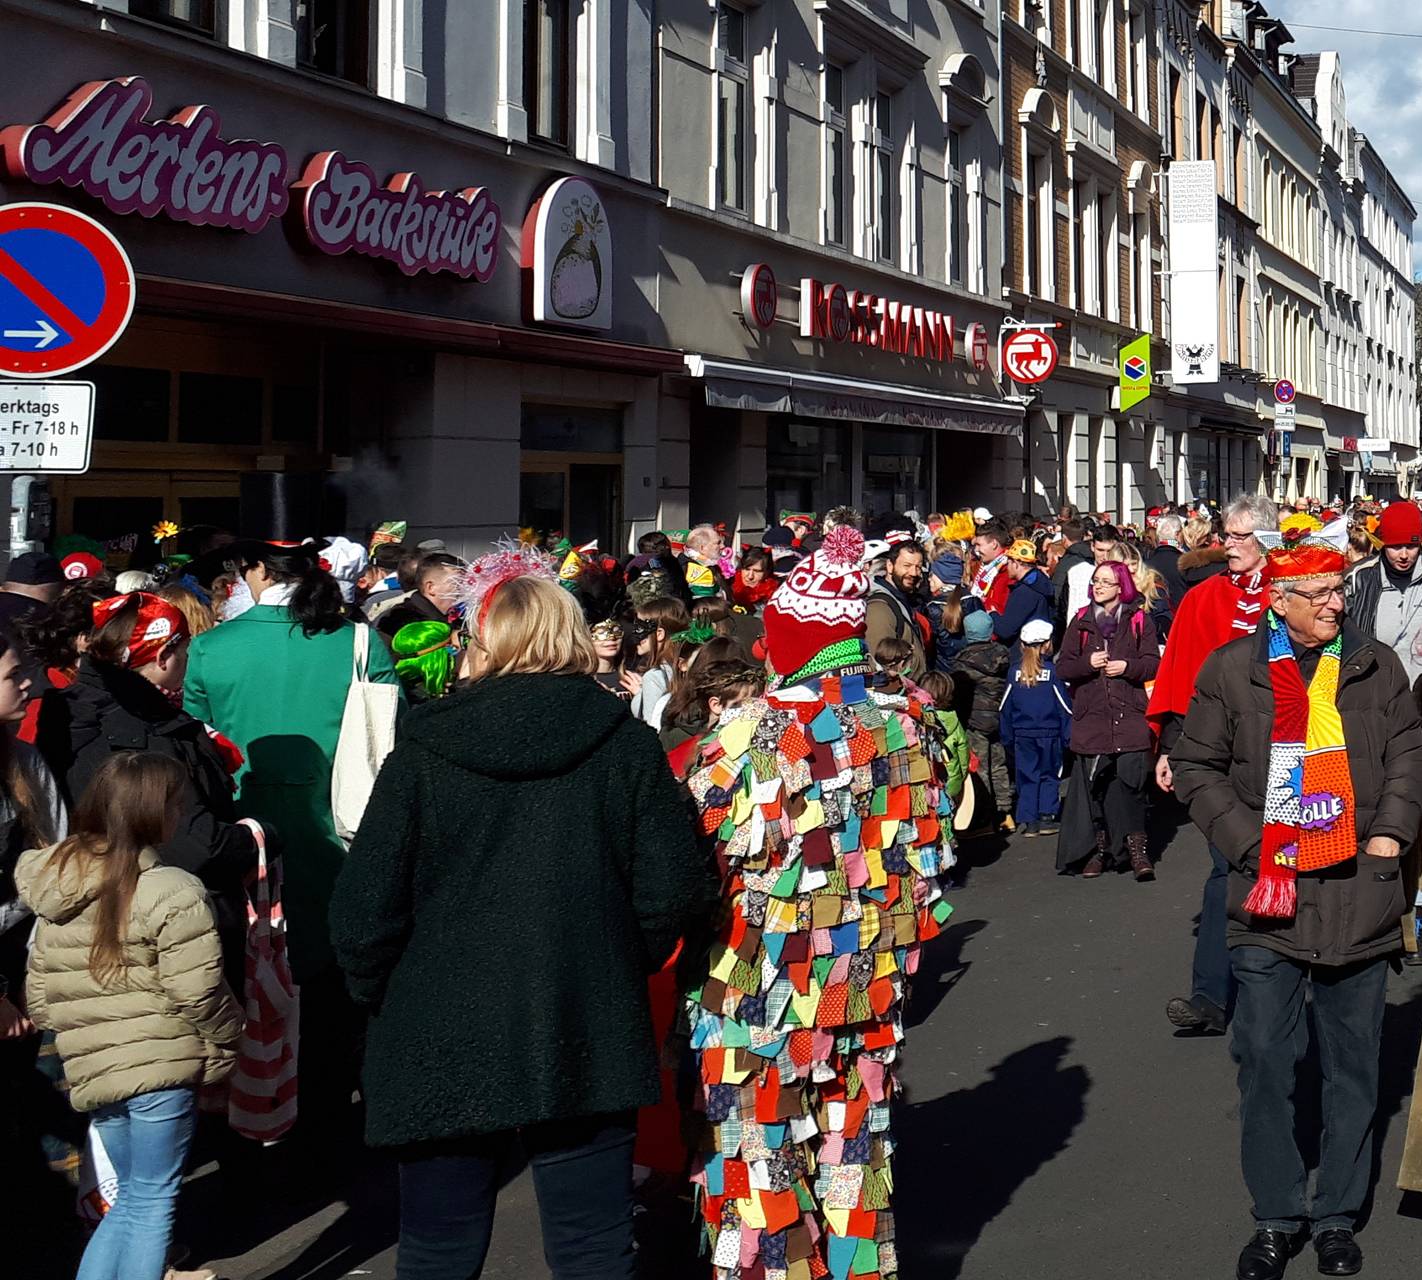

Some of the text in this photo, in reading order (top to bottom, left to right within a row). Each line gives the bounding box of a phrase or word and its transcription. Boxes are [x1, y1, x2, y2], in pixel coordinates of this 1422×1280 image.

[800, 278, 955, 364] ROSSMANN
[0, 399, 60, 417] erktags
[12, 420, 29, 435] Fr
[34, 420, 66, 436] 7-18
[70, 421, 79, 436] h
[11, 442, 45, 457] 7-10
[49, 442, 58, 457] h
[788, 563, 869, 598] ÖLN
